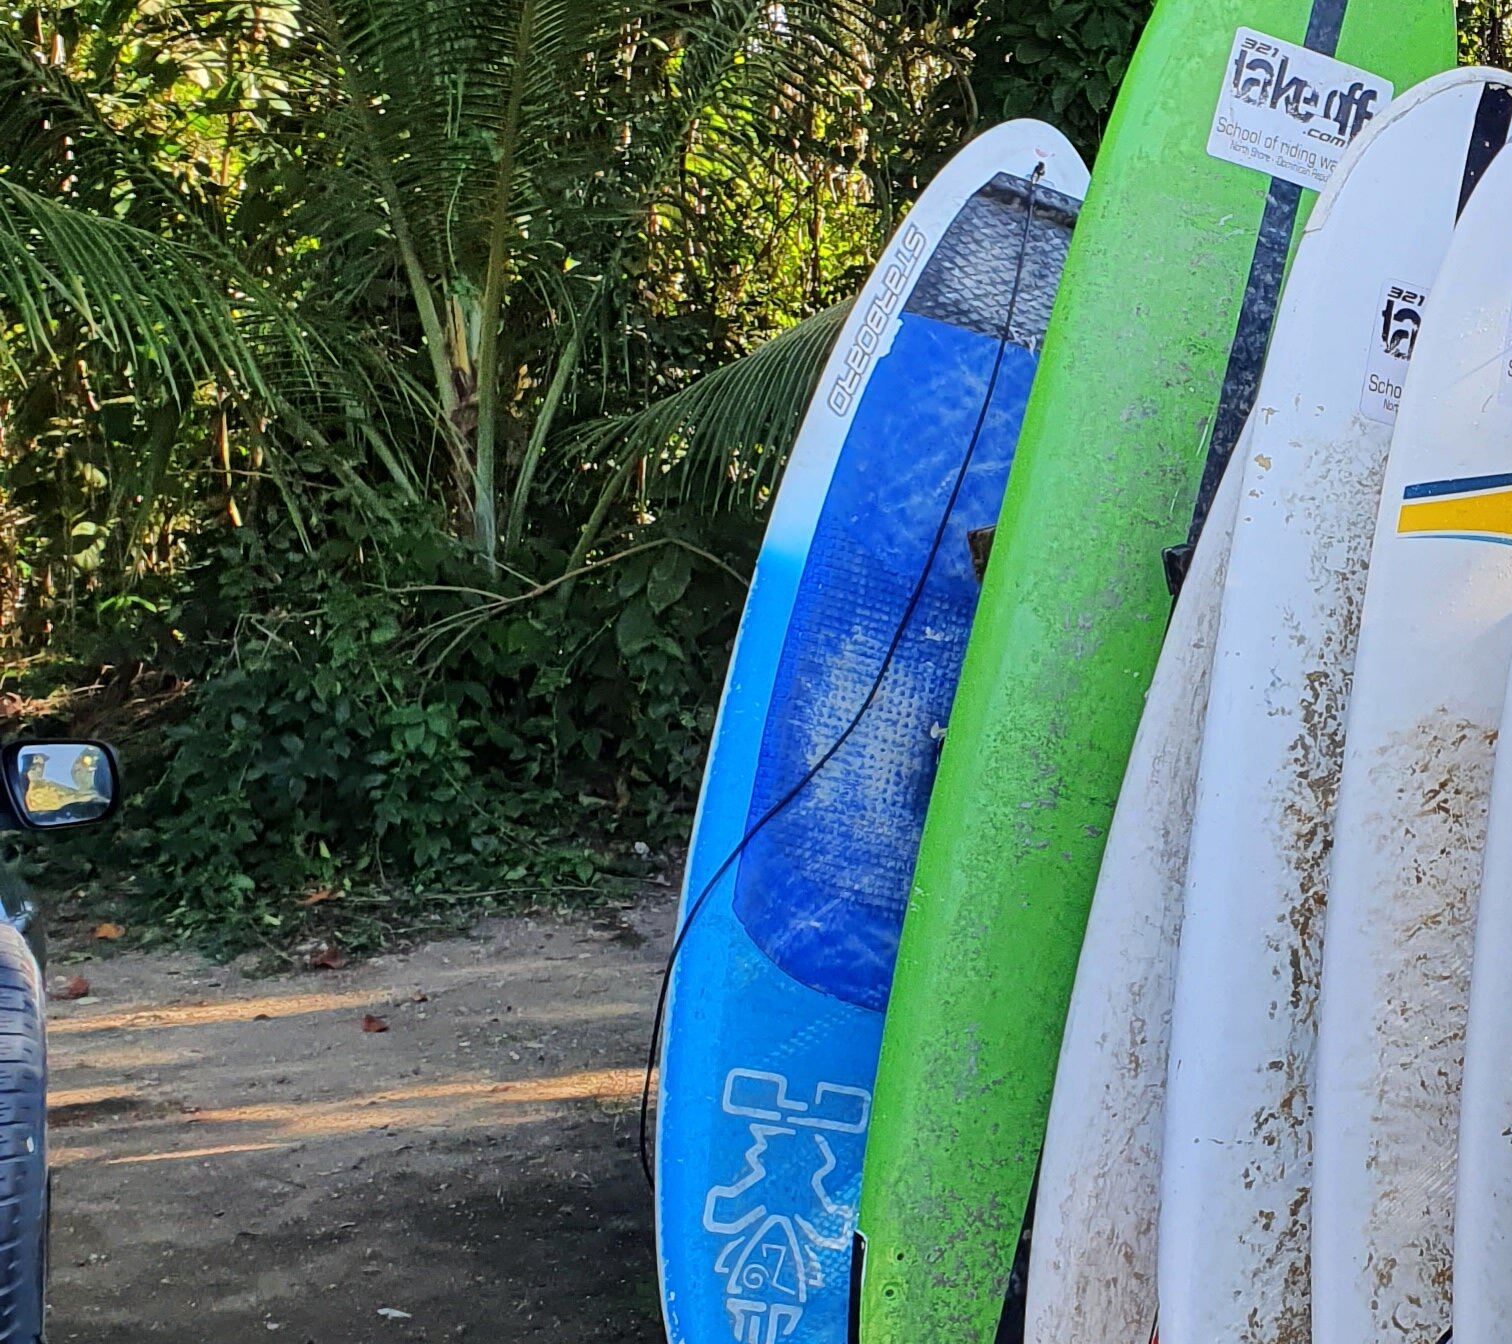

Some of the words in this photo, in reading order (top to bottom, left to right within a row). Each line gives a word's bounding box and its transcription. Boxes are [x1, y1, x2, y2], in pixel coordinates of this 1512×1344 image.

[1241, 38, 1280, 57] 321
[1216, 117, 1262, 144] School
[1264, 135, 1279, 148] of
[1280, 139, 1317, 169] riding
[1303, 128, 1346, 147] .com
[1387, 286, 1425, 306] 321
